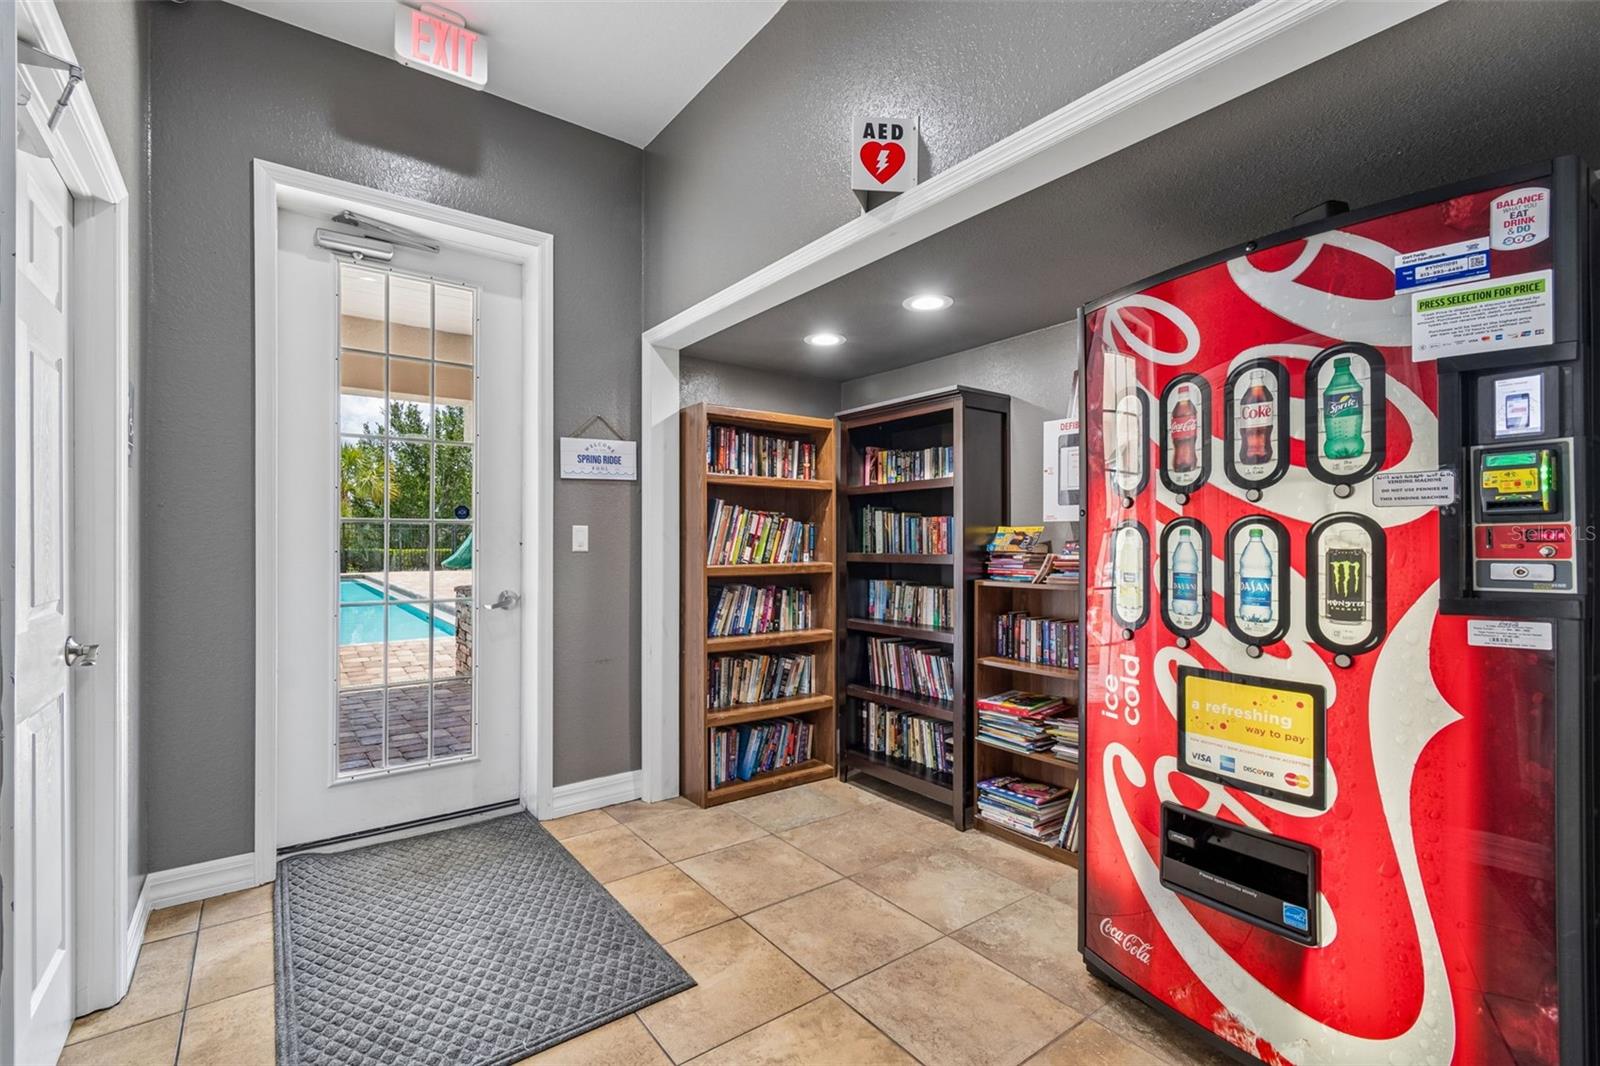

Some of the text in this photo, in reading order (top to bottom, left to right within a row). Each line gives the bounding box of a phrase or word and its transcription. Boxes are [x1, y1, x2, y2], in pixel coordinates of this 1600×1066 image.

[411, 11, 478, 77] EXIT
[863, 122, 904, 140] AED
[1496, 192, 1544, 209] BALANCE
[1503, 205, 1521, 213] WHAT
[1504, 216, 1536, 228] DRINK
[1510, 209, 1528, 219] EAT
[1516, 224, 1531, 233] DO
[1419, 281, 1541, 310] PRESS SELECTION FOR PRICE
[1242, 404, 1272, 420] Coke
[1329, 399, 1356, 414] Sprite
[577, 454, 622, 465] SPRING RIDGE
[1102, 674, 1119, 720] ice
[1120, 653, 1140, 726] cold
[1191, 699, 1292, 729] a refreshing
[1245, 725, 1305, 745] way to pay
[1191, 752, 1275, 778] VISA DISCOVER
[1100, 917, 1154, 965] Coca-Cola
